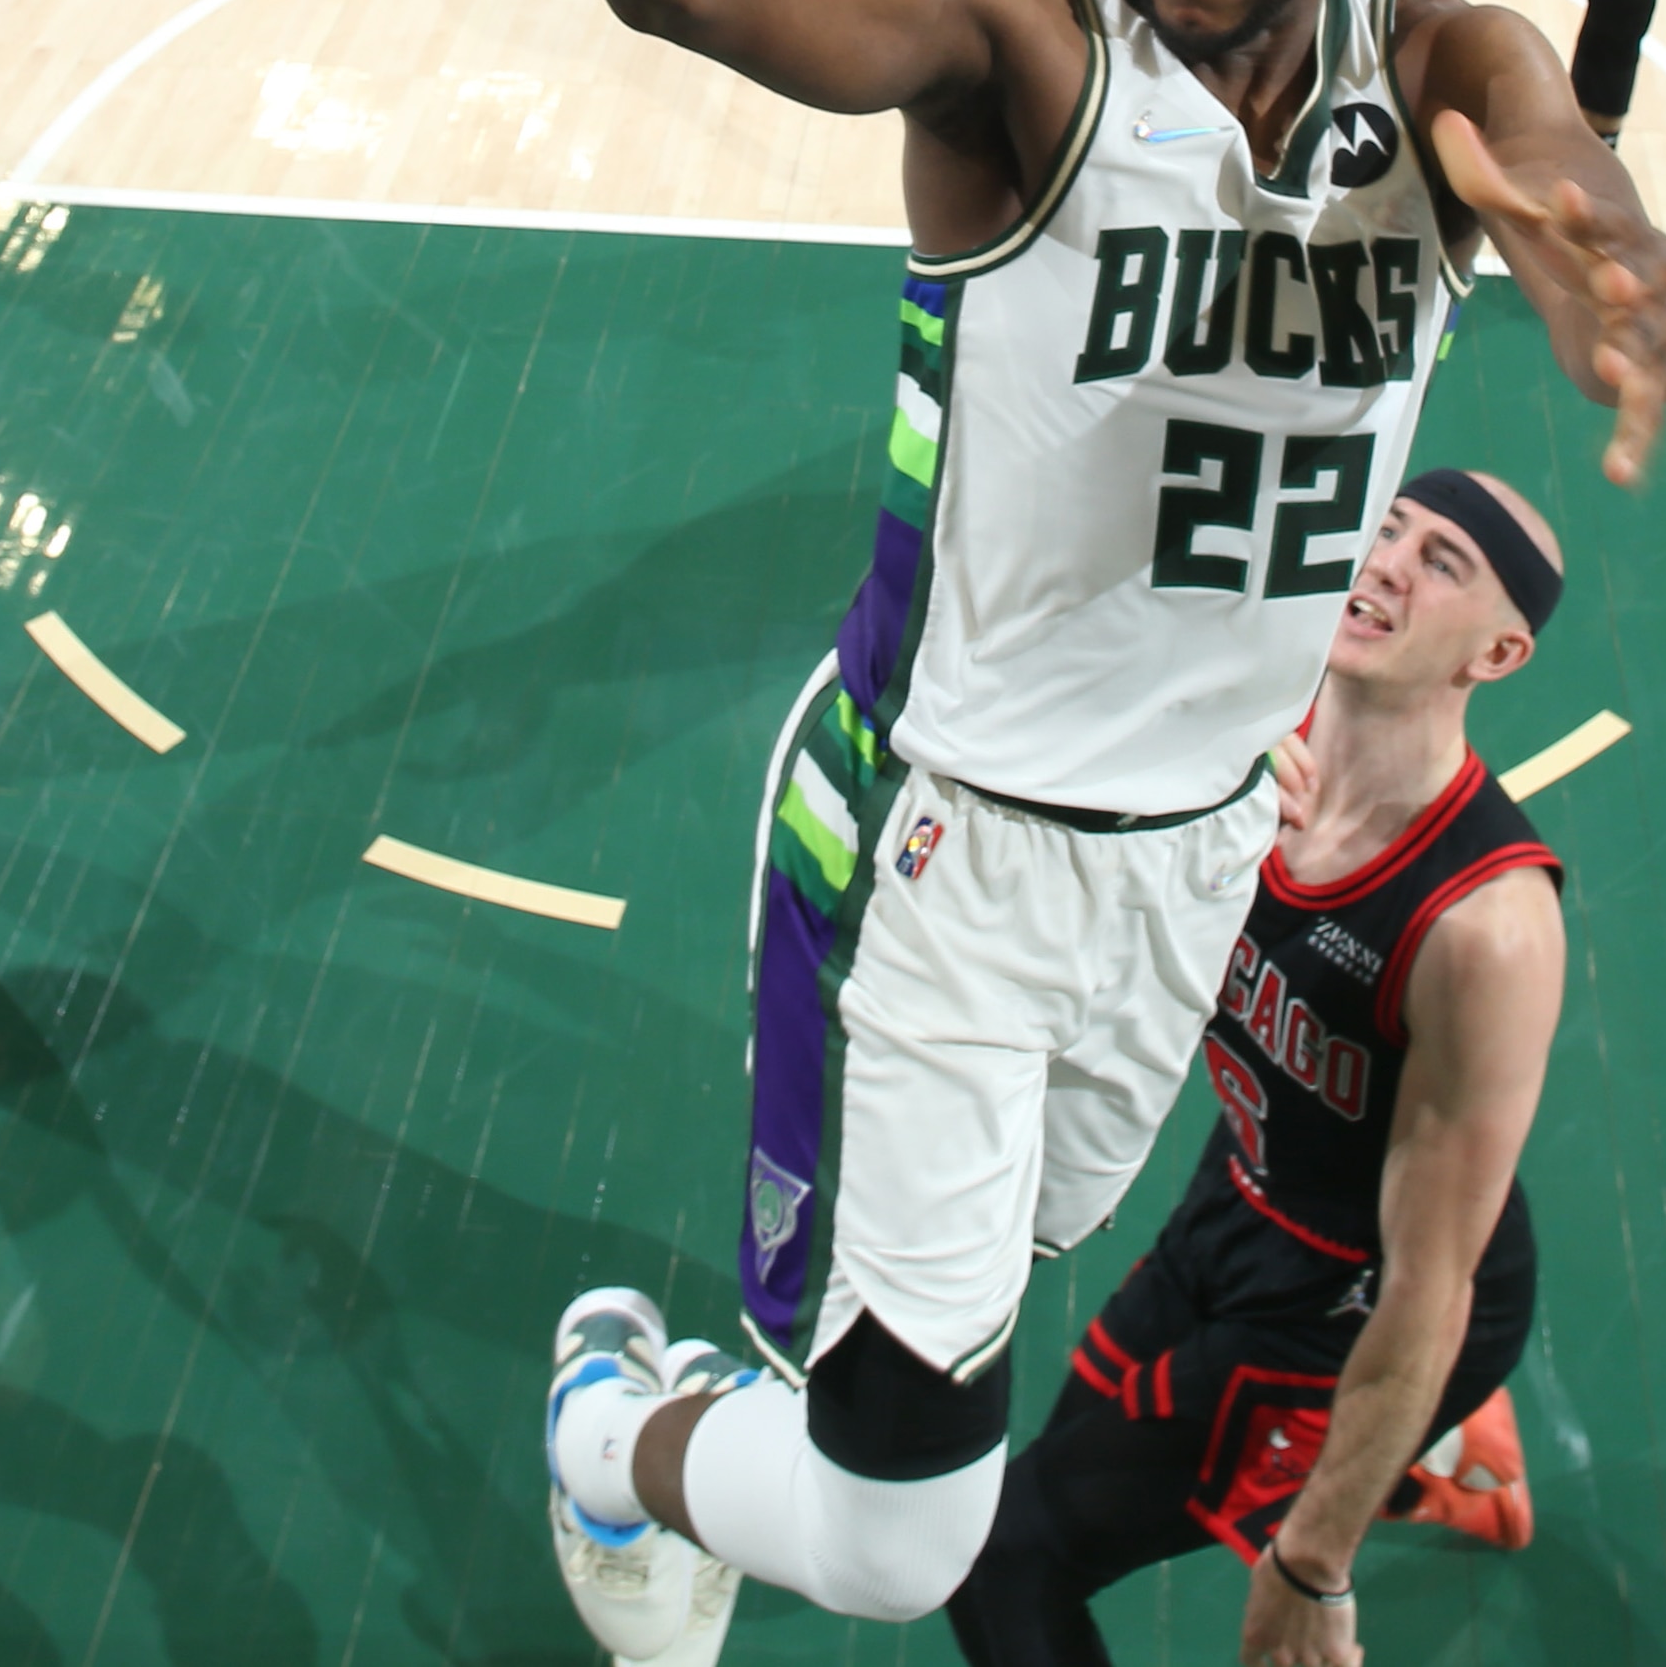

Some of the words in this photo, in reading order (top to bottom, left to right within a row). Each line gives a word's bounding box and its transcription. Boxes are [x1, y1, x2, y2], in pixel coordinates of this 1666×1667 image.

[1073, 226, 1420, 389] BUCKS
[1151, 418, 1376, 600] 22
[1219, 931, 1371, 1121] CAGO
